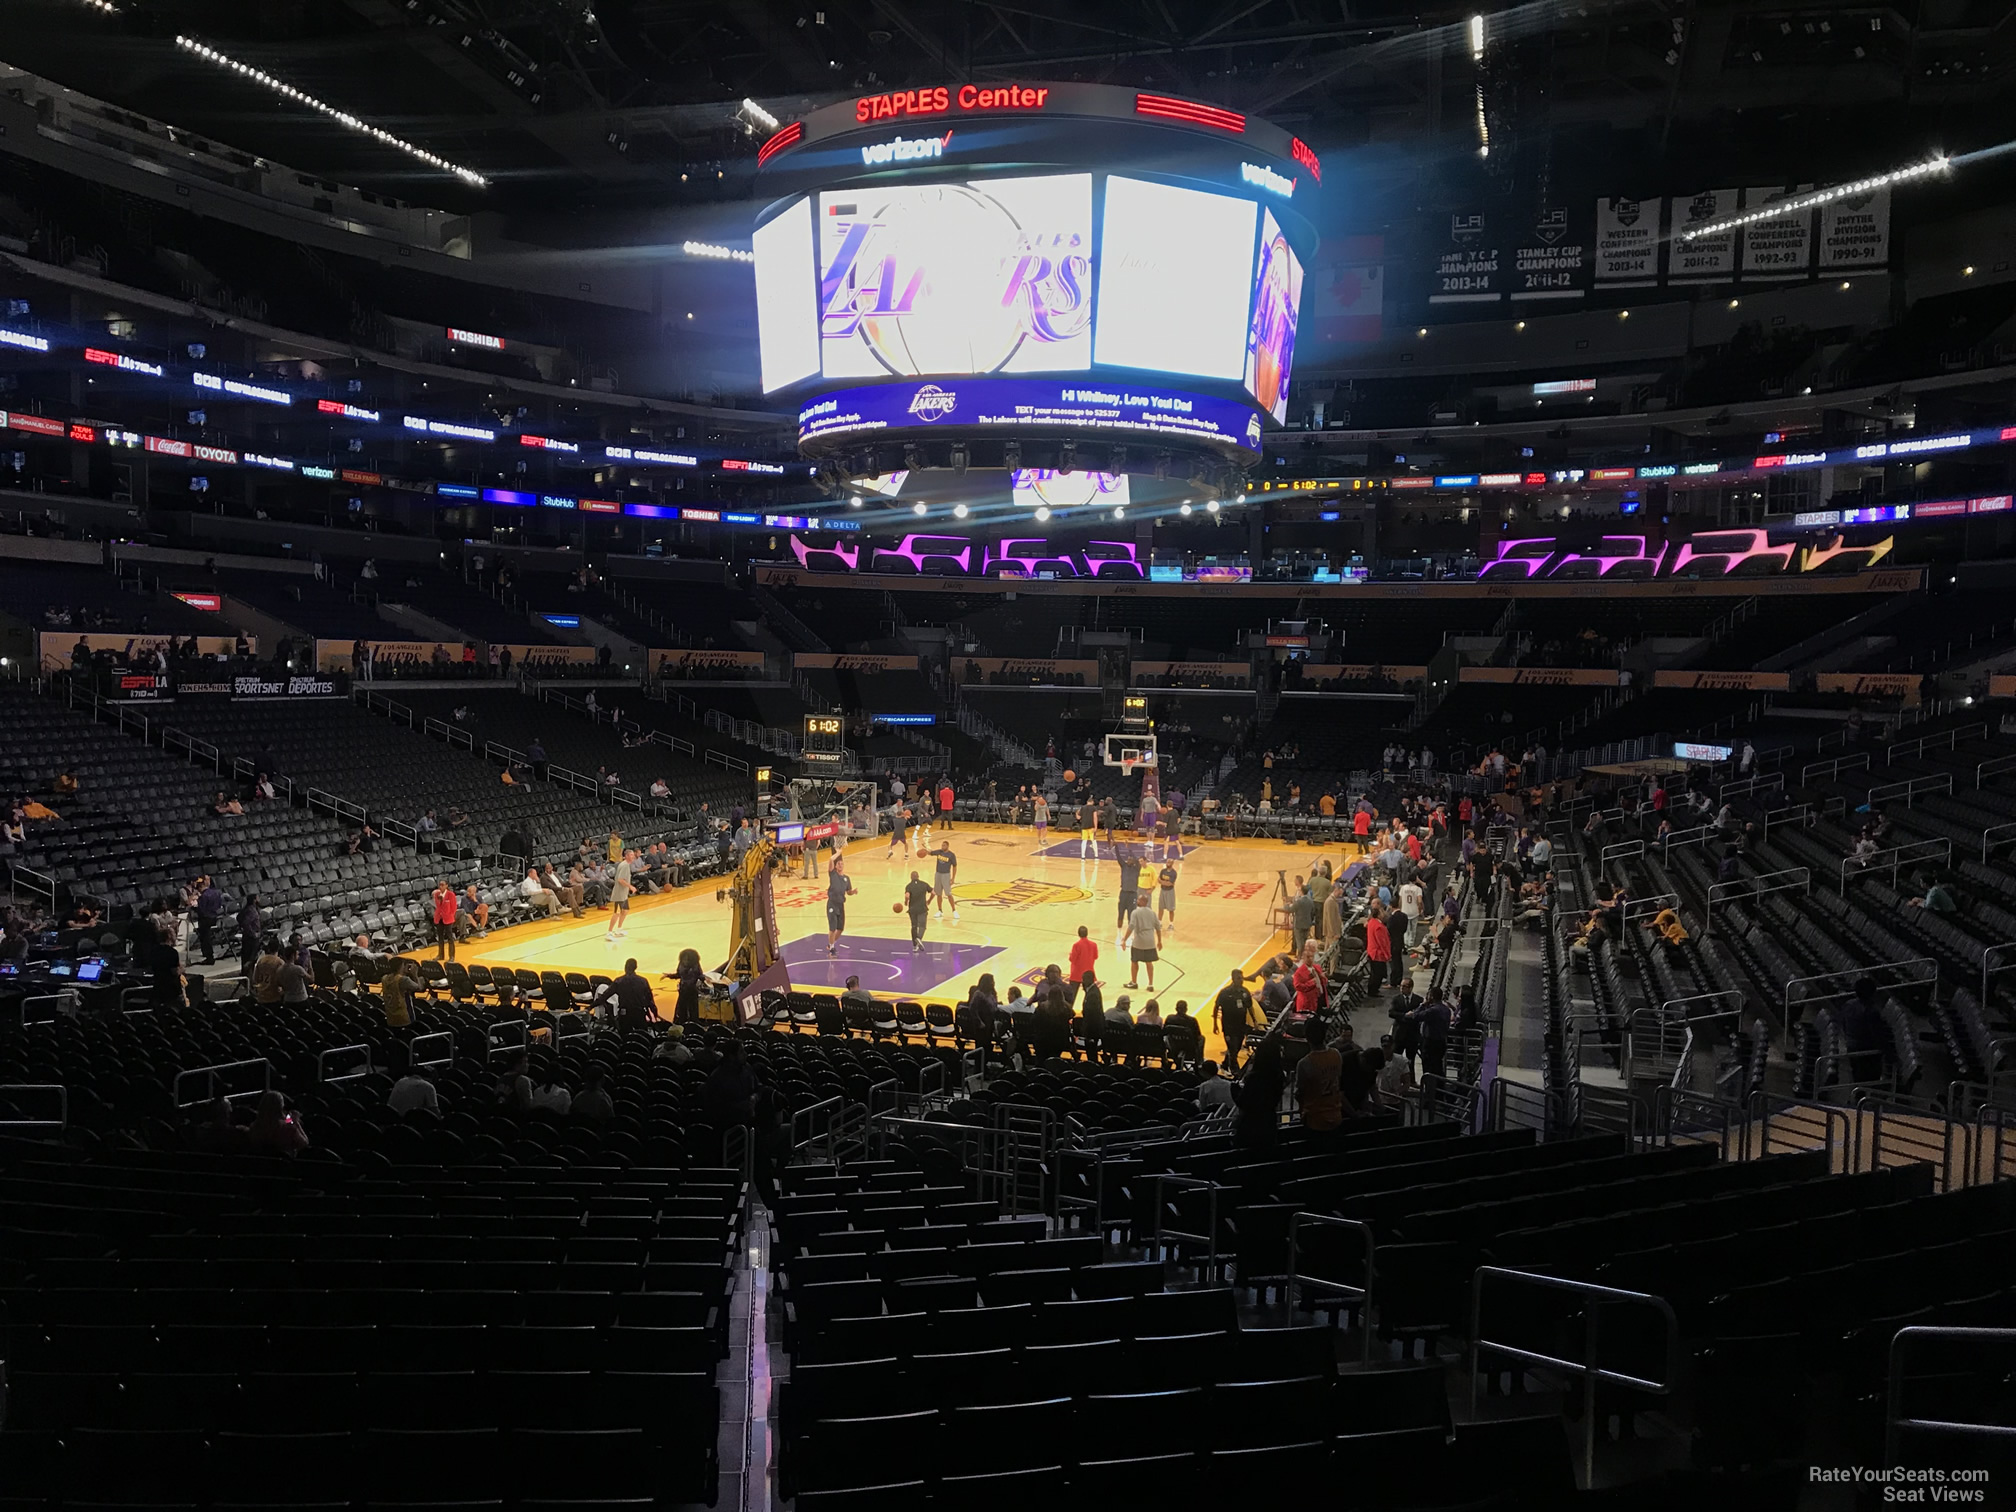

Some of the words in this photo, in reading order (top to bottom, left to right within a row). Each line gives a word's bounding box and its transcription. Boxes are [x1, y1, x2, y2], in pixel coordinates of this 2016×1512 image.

[856, 87, 949, 122] STAPLES
[958, 84, 1048, 109] Center
[862, 136, 941, 165] verizon
[1754, 219, 1802, 230] CAMPBELL
[1836, 214, 1874, 225] SMYTHE
[1607, 229, 1648, 239] WESTERN
[1748, 229, 1807, 240] CONFERENCE
[1834, 224, 1876, 235] DIVISION
[1750, 239, 1803, 250] CHAMPIONS
[1827, 234, 1882, 246] CHAMPIONS
[1516, 247, 1558, 260] STANLEY
[1560, 246, 1582, 257] CUP
[1602, 249, 1652, 260] CHAMPIONS
[1755, 252, 1797, 264] 1992-93
[1832, 247, 1875, 260] 1990-91
[1516, 256, 1582, 271] CHAMPIONS
[1608, 260, 1645, 272] 2013-14
[1442, 275, 1489, 291] 2013-14
[451, 329, 500, 348] TOSHIBA
[907, 393, 958, 414] LAKERS
[1124, 393, 1149, 406] Love
[1174, 398, 1192, 412] Dad
[1015, 406, 1034, 414] TEXT
[979, 415, 992, 423] The
[993, 415, 1017, 423] Lakers
[1018, 415, 1032, 423] will
[1032, 416, 1061, 424] confirm
[1061, 418, 1087, 426] receipt
[45, 422, 65, 432] CASINO
[72, 425, 92, 433] TEAM
[70, 431, 94, 441] FOULS
[194, 445, 237, 463] TOYOTA
[302, 465, 334, 479] verizon
[1640, 466, 1676, 477] StubHub
[1684, 463, 1719, 475] verizon
[1353, 480, 1361, 489] 0
[1480, 474, 1521, 484] TOSHIBA
[1263, 481, 1271, 491] 0
[543, 495, 575, 508] StubHub
[682, 509, 720, 522] TOSHIBA
[727, 514, 739, 522] BUD
[1796, 511, 1839, 525] STAPLES
[833, 521, 861, 530] DELTA
[765, 570, 798, 584] LAKERS
[1867, 573, 1911, 591] LAKERS
[121, 675, 156, 690] ESPN
[155, 675, 168, 688] LA
[289, 675, 316, 683] SPECTRUM
[177, 683, 231, 693] LAKERS.COM
[235, 682, 285, 694] SPORTSNET
[288, 681, 333, 694] DEPORTES
[813, 827, 832, 838] AAA.com
[1407, 894, 1413, 904] 0
